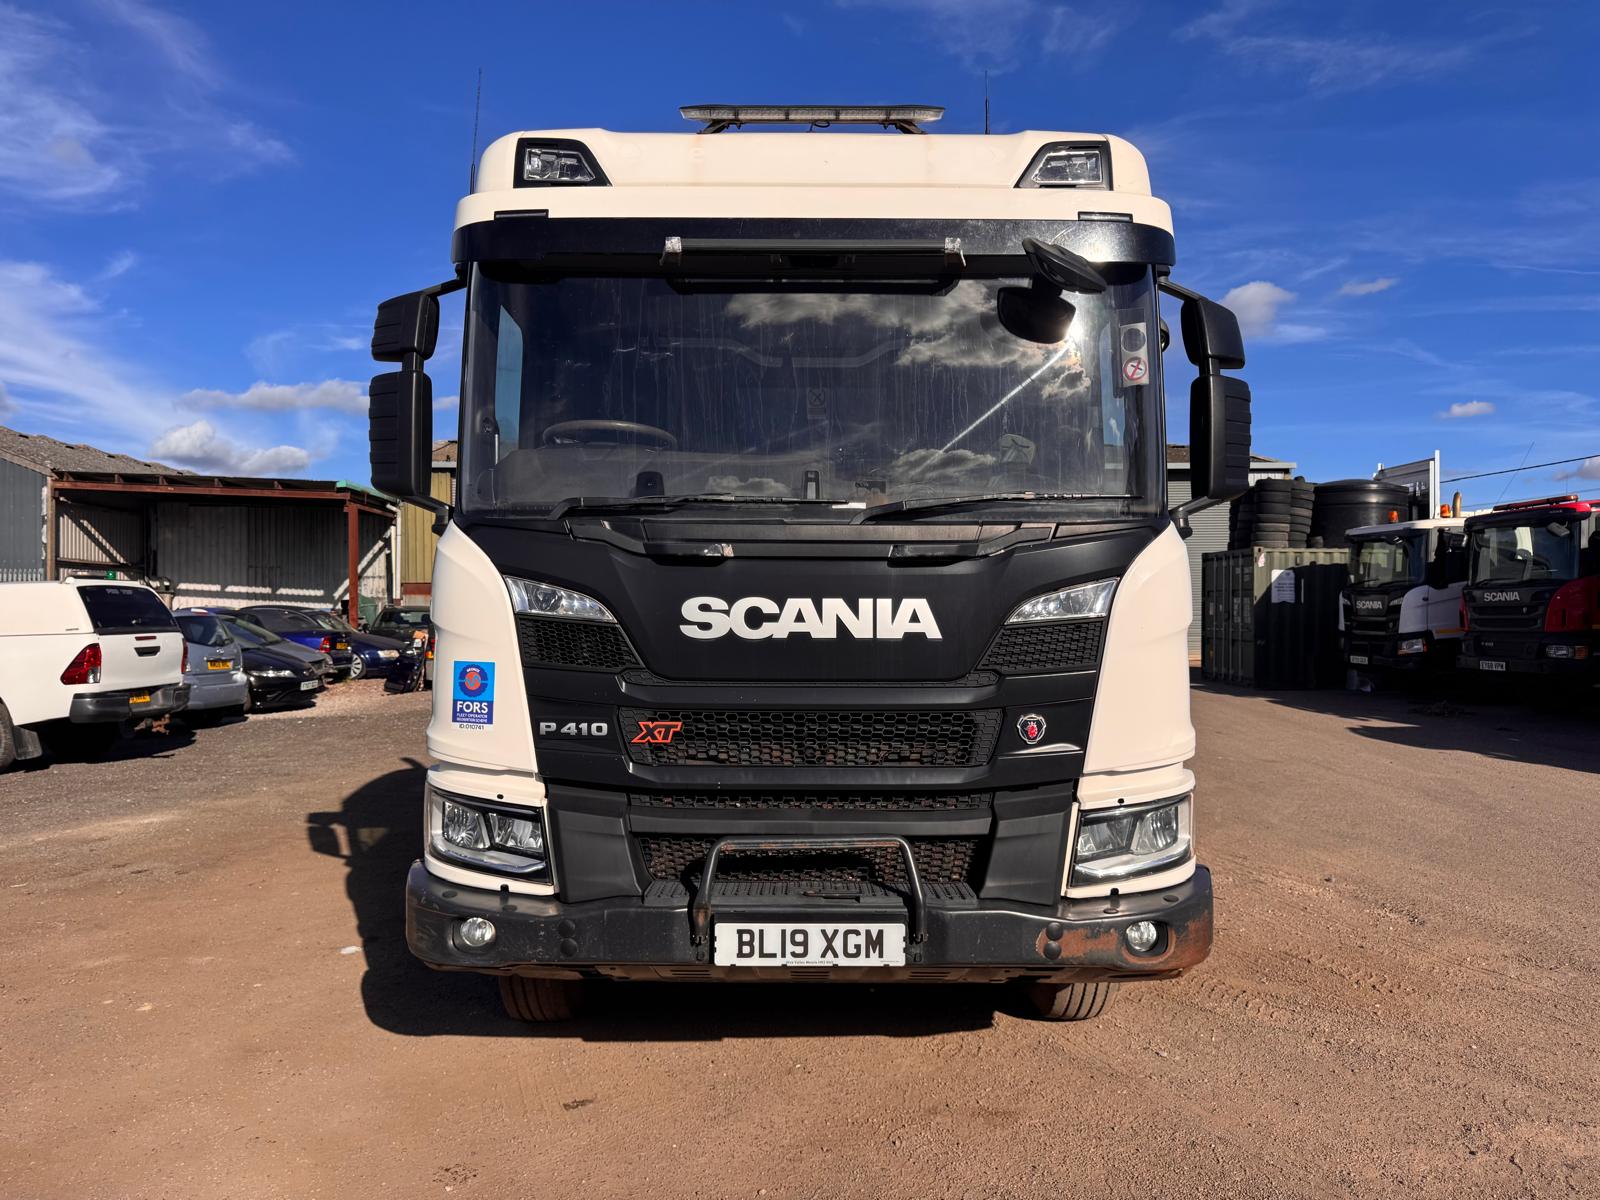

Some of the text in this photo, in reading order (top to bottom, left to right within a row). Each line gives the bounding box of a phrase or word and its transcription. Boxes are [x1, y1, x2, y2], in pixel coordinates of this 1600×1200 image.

[1484, 591, 1520, 602] SCANIA
[1356, 600, 1383, 609] SCANIA
[680, 596, 943, 640] SCANIA
[457, 700, 488, 713] FORS
[539, 722, 608, 736] P 410
[631, 721, 682, 743] XT
[736, 928, 884, 959] BL19 XGM
